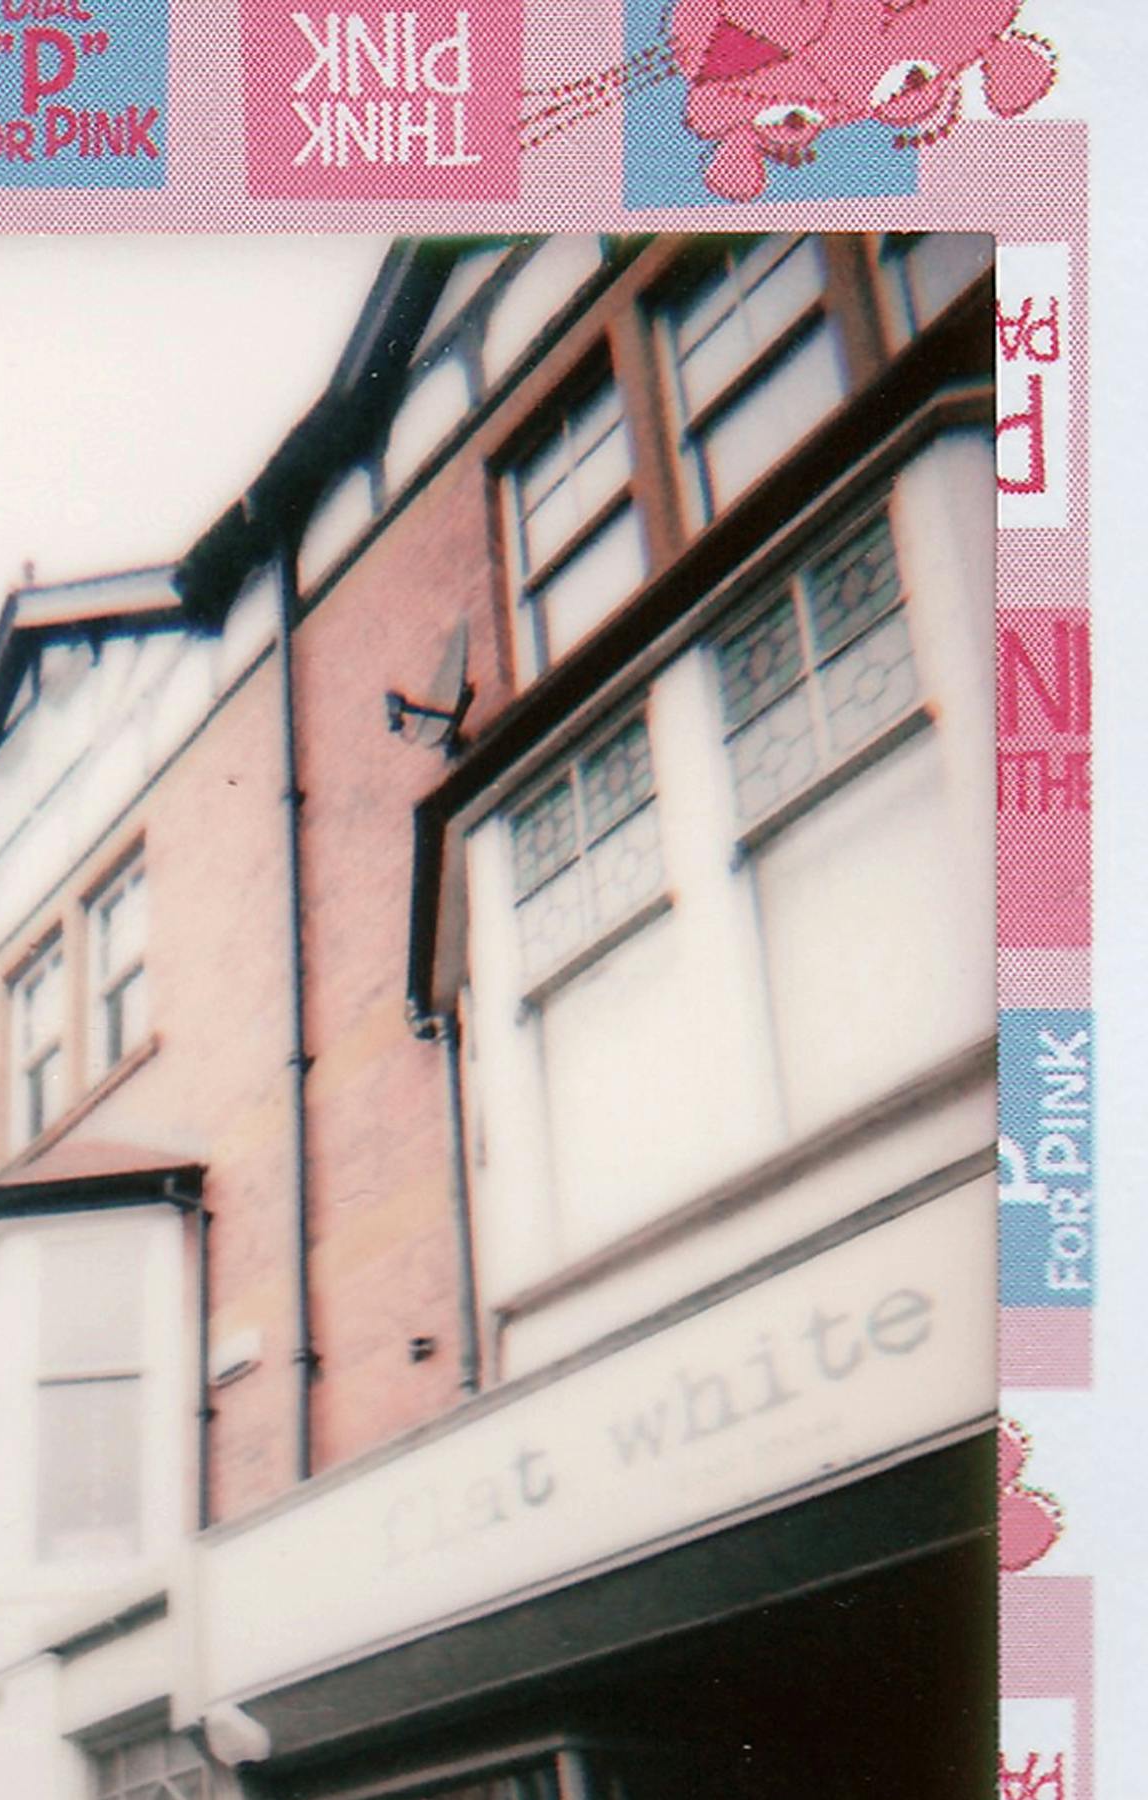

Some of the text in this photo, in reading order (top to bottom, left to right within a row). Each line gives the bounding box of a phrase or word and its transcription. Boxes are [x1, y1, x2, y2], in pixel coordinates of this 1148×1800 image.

[290, 10, 471, 96] PINK
[44, 102, 160, 159] PINK
[290, 100, 482, 167] THINK
[1036, 1030, 1091, 1290] FOR PINK
[608, 1288, 934, 1467] white
